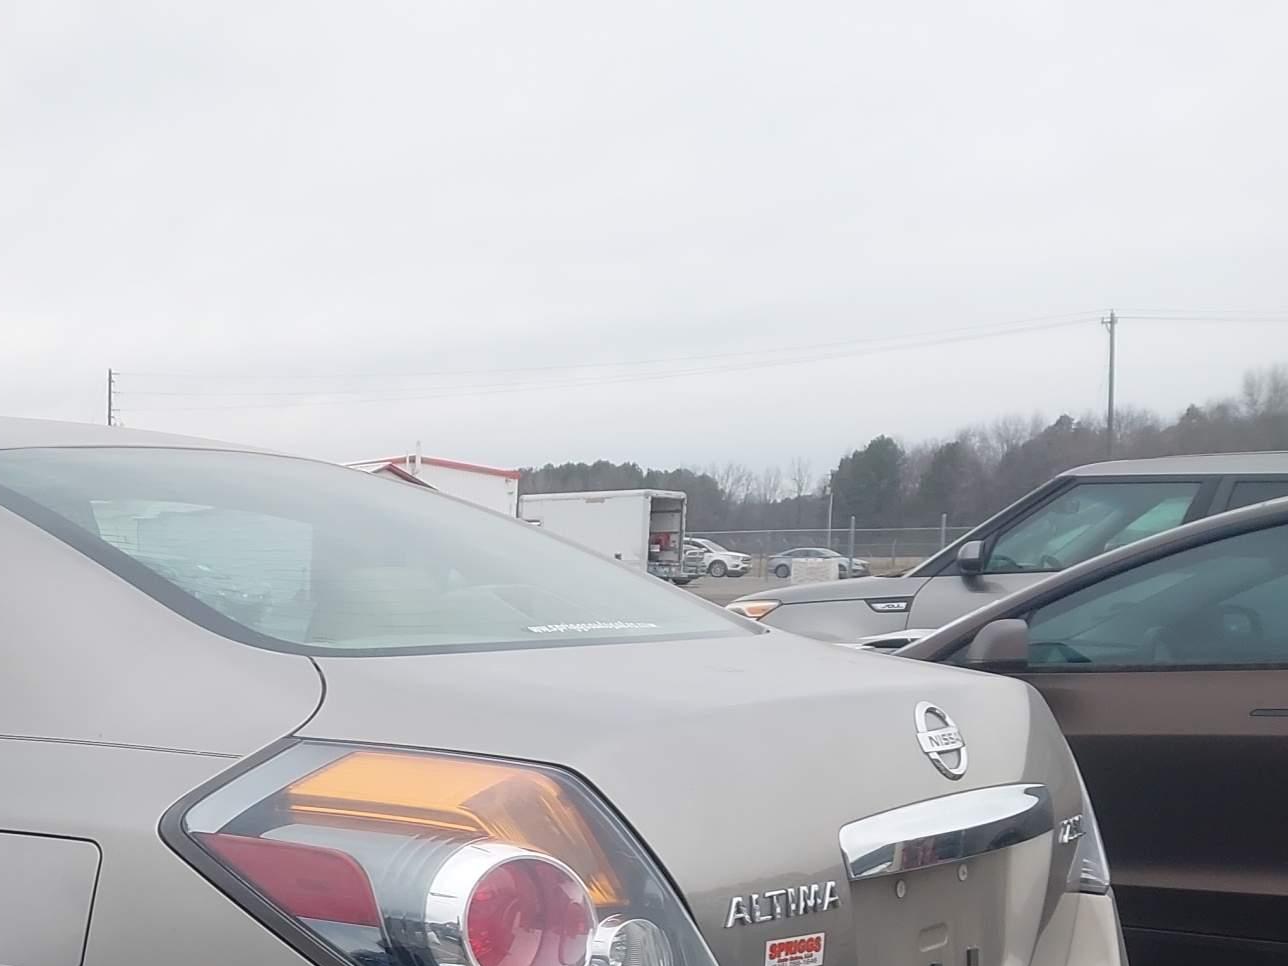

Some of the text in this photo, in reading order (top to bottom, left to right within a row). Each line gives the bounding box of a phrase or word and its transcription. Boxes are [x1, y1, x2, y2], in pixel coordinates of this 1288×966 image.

[927, 731, 963, 747] NISS
[725, 881, 839, 928] ALTIMA
[769, 936, 822, 960] SPRIGGS
